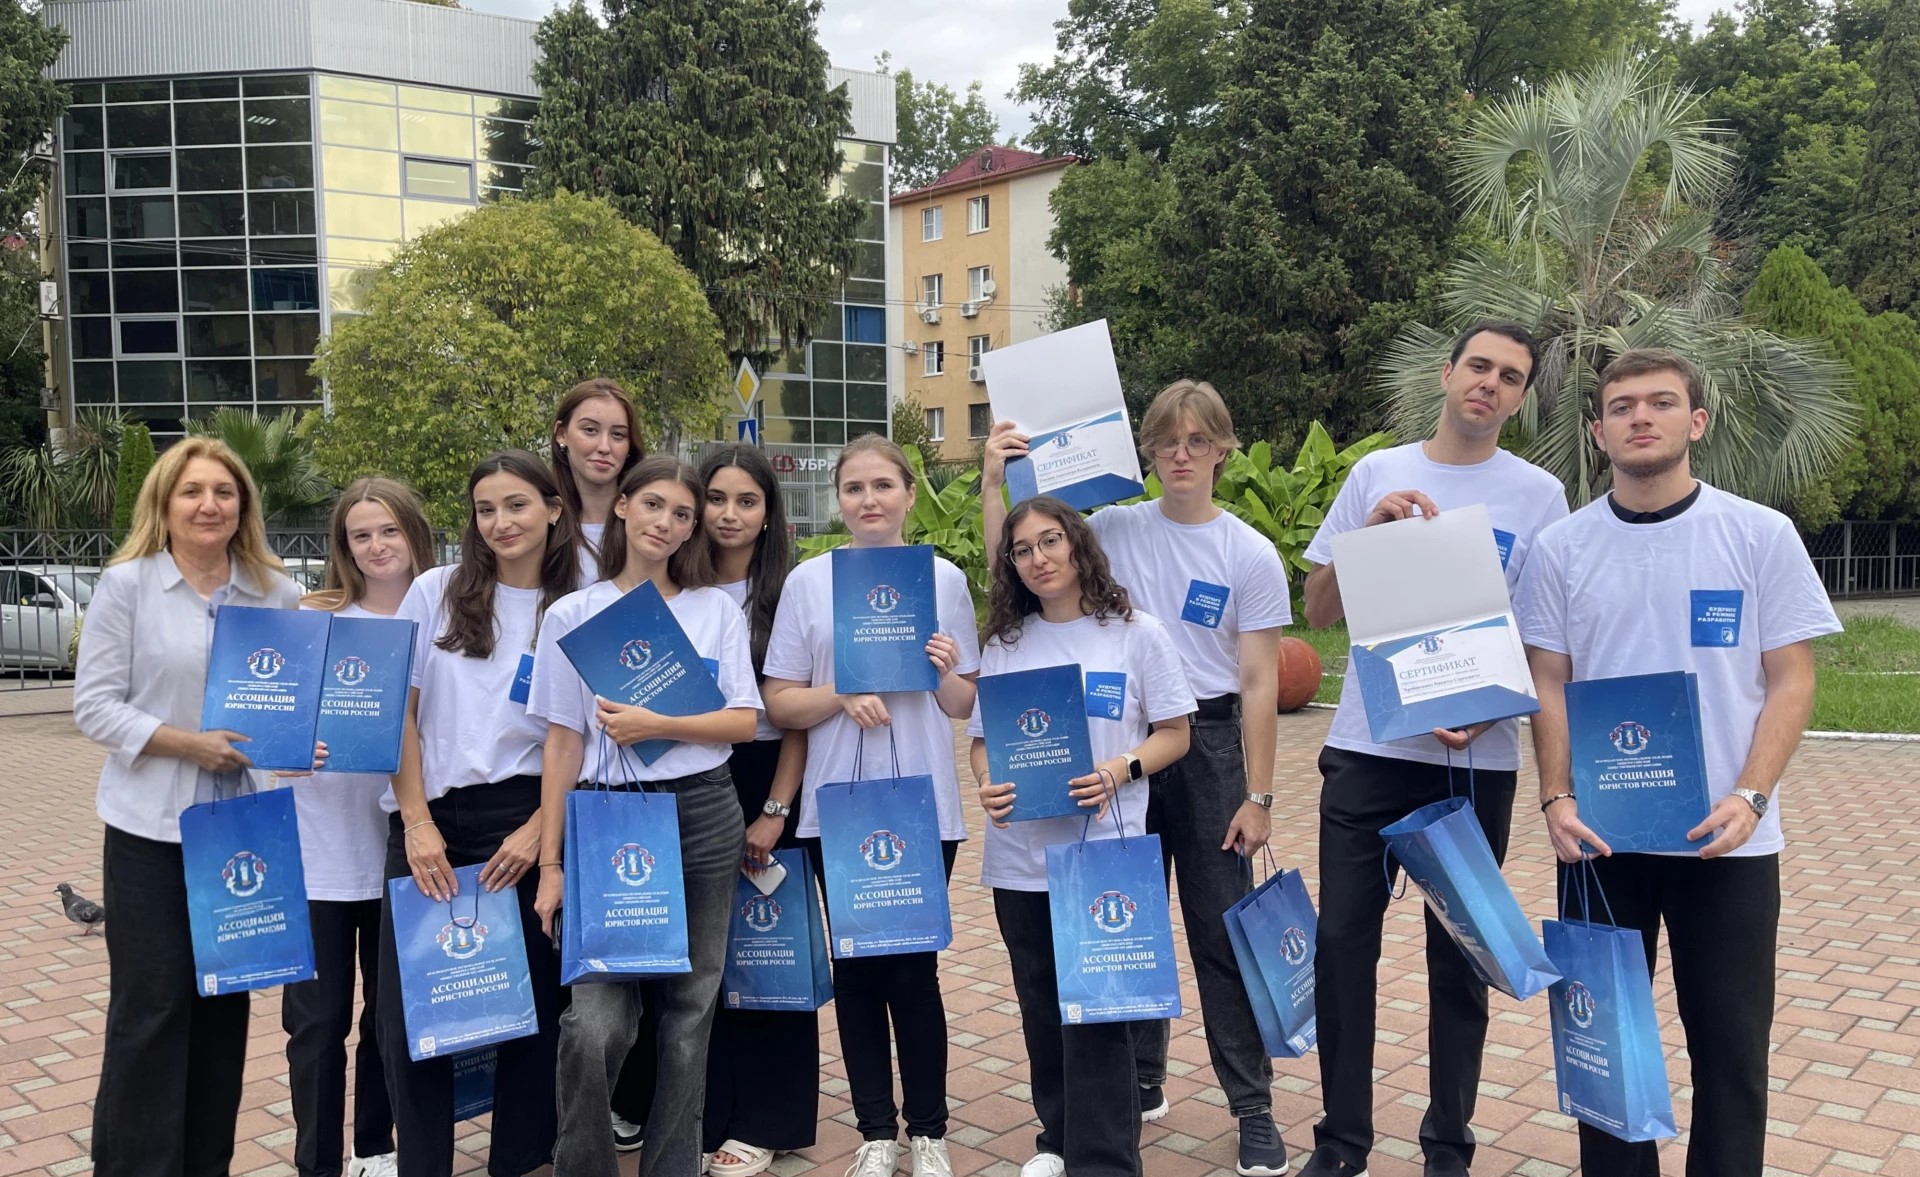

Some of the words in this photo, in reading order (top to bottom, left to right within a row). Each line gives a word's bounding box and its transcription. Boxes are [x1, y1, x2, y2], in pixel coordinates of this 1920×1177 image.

[798, 458, 837, 470] УБРи
[1037, 449, 1098, 472] СЕРТИФИКАТ
[854, 626, 914, 635] АССОЦИАЦИЯ
[1400, 657, 1476, 680] СЕРТИФИКАТ
[226, 693, 296, 704] АССОЦИАЦИЯ
[321, 700, 380, 709] ССОЦИАЦИЯ
[224, 702, 262, 710] ЮРИСТОВ
[320, 708, 350, 716] РИСТОВ
[1009, 748, 1070, 762] АССОЦИАЦИЯ
[1009, 760, 1043, 770] ЮРИСТОВ
[1044, 756, 1072, 765] РОССИИ
[1598, 770, 1674, 782] АССОЦИАЦИЯ
[1599, 782, 1640, 790] ЮРИСТОВ
[1642, 780, 1676, 788] РОССИИ
[854, 887, 922, 902] АССОЦИАЦИЯ
[854, 901, 892, 910] ЮРИСТОВ
[893, 898, 924, 906] РОССИИ
[605, 906, 668, 918] АССОЦИАЦИЯ
[604, 919, 640, 928] ЮРИСТОВ
[642, 918, 668, 926] РОССИИ
[736, 950, 794, 958] АССОЦИАЦИЯ
[1082, 951, 1155, 964] АССОЦИАЦИЯ
[1082, 964, 1122, 974] ЮРИСТОВ
[1124, 962, 1157, 970] РОССИИ
[431, 972, 508, 995] АССОЦИАЦИЯ
[1290, 974, 1315, 1000] АССОЦИ
[432, 990, 474, 1004] ЮРИСТОВ
[476, 982, 510, 994] РОССИИ
[1566, 1046, 1608, 1068] АССОЦИАЦИЯ
